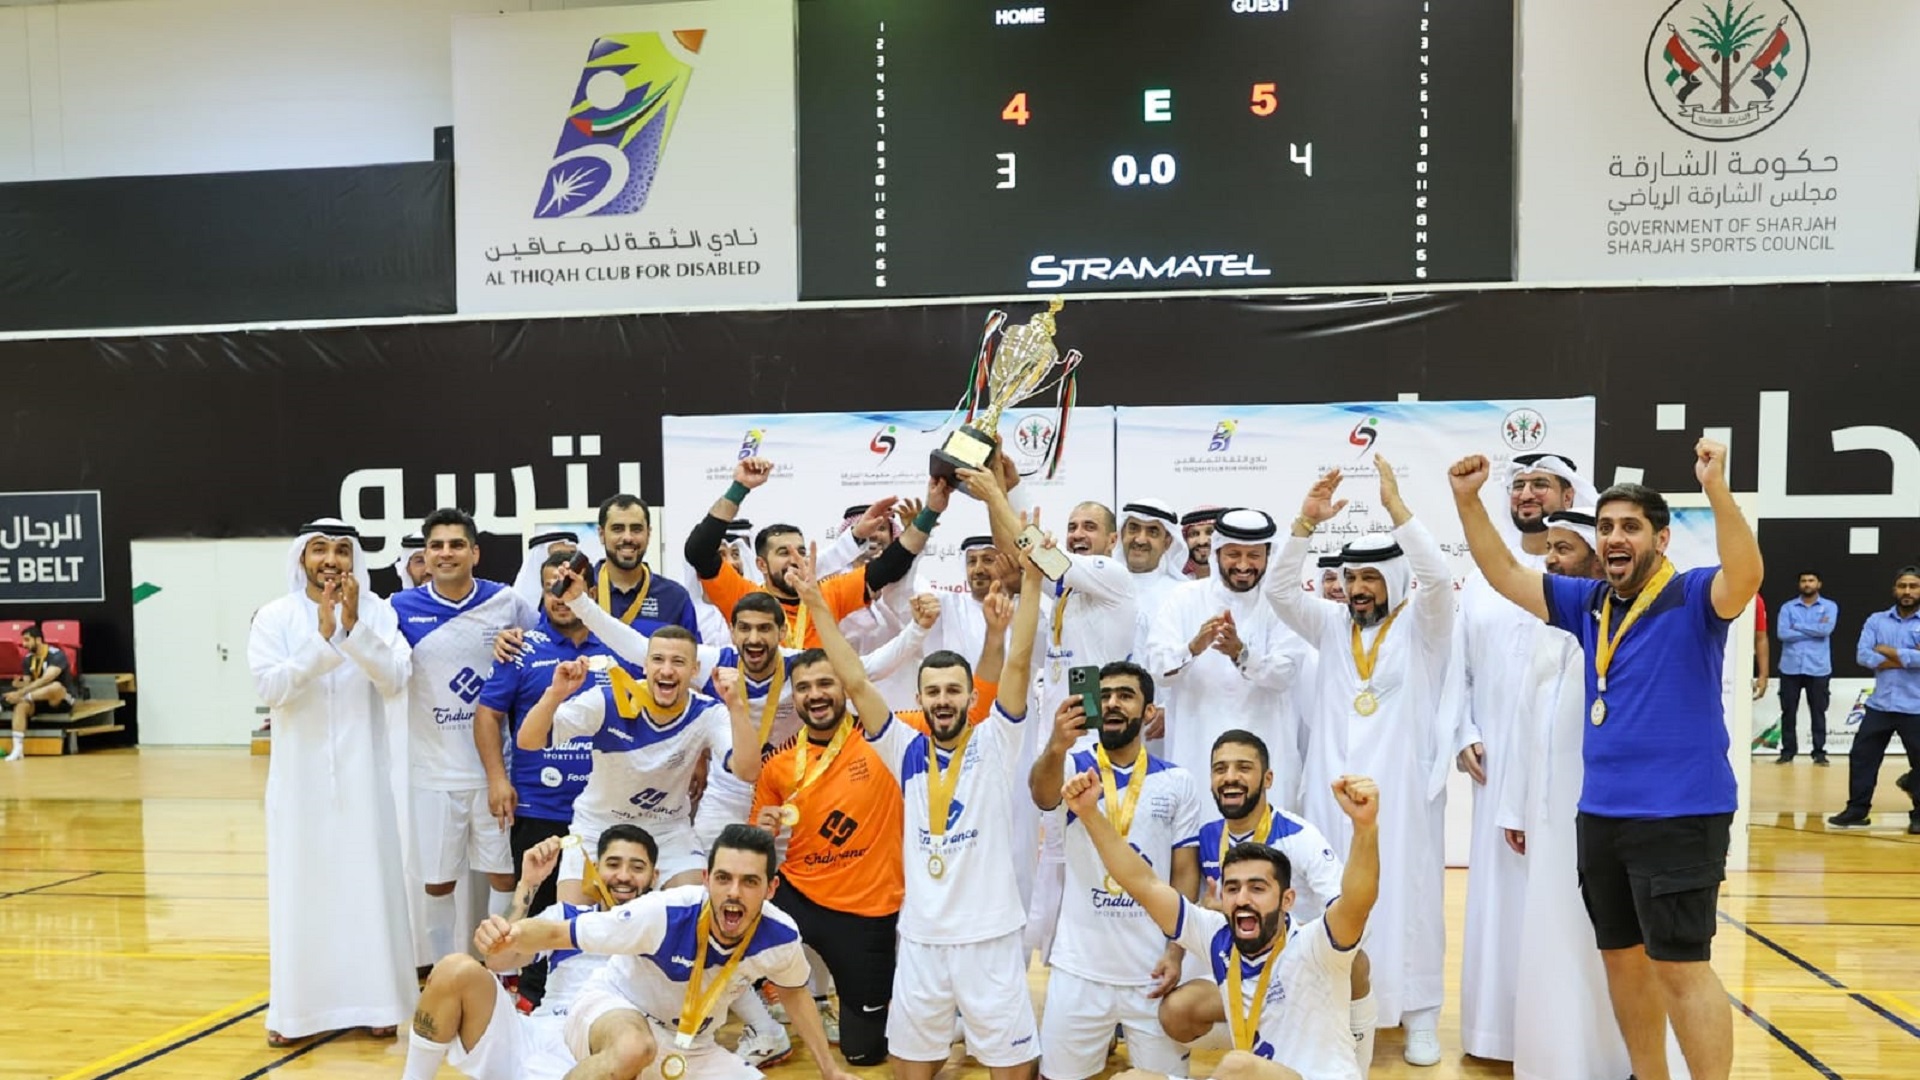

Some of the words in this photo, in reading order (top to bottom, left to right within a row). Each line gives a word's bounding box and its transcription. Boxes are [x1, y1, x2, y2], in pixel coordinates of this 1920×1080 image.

[996, 8, 1045, 25] HOME
[1231, 0, 1290, 13] GUEST
[1420, 19, 1429, 31] 2
[876, 38, 884, 50] 2
[1420, 37, 1429, 49] 3
[877, 55, 885, 67] 3
[1420, 73, 1428, 84] 5
[877, 89, 885, 101] 5
[1144, 89, 1171, 122] E
[1250, 82, 1278, 116] 5
[1002, 92, 1030, 126] 4
[996, 152, 1016, 189] 3
[1111, 153, 1176, 186] 0.0
[1289, 142, 1312, 177] 4
[1608, 150, 1717, 183] الشارقة
[1728, 148, 1838, 181] حكومة
[1608, 185, 1681, 215] الرياضي
[1688, 182, 1763, 209] الشارقة
[1770, 182, 1838, 207] مجلس
[625, 228, 702, 250] الثقة
[1607, 218, 1724, 236] GOVERNMENT
[1728, 217, 1751, 233] OF
[1756, 216, 1837, 233] SHARJAH
[485, 232, 620, 262] للمعاقين
[707, 227, 758, 257] نادي
[1607, 238, 1685, 255] SHARJAH
[1690, 236, 1757, 253] SPORTS
[1762, 235, 1834, 252] COUNCIL
[485, 270, 505, 285] AL
[510, 267, 579, 286] THIQAH
[585, 266, 630, 281] CLUB
[636, 263, 671, 279] FOR
[677, 260, 761, 277] DISABLED
[1027, 254, 1271, 289] STRAMATEL
[0, 513, 82, 549] الرجال
[18, 556, 84, 582] BELT
[432, 707, 476, 724] Endur
